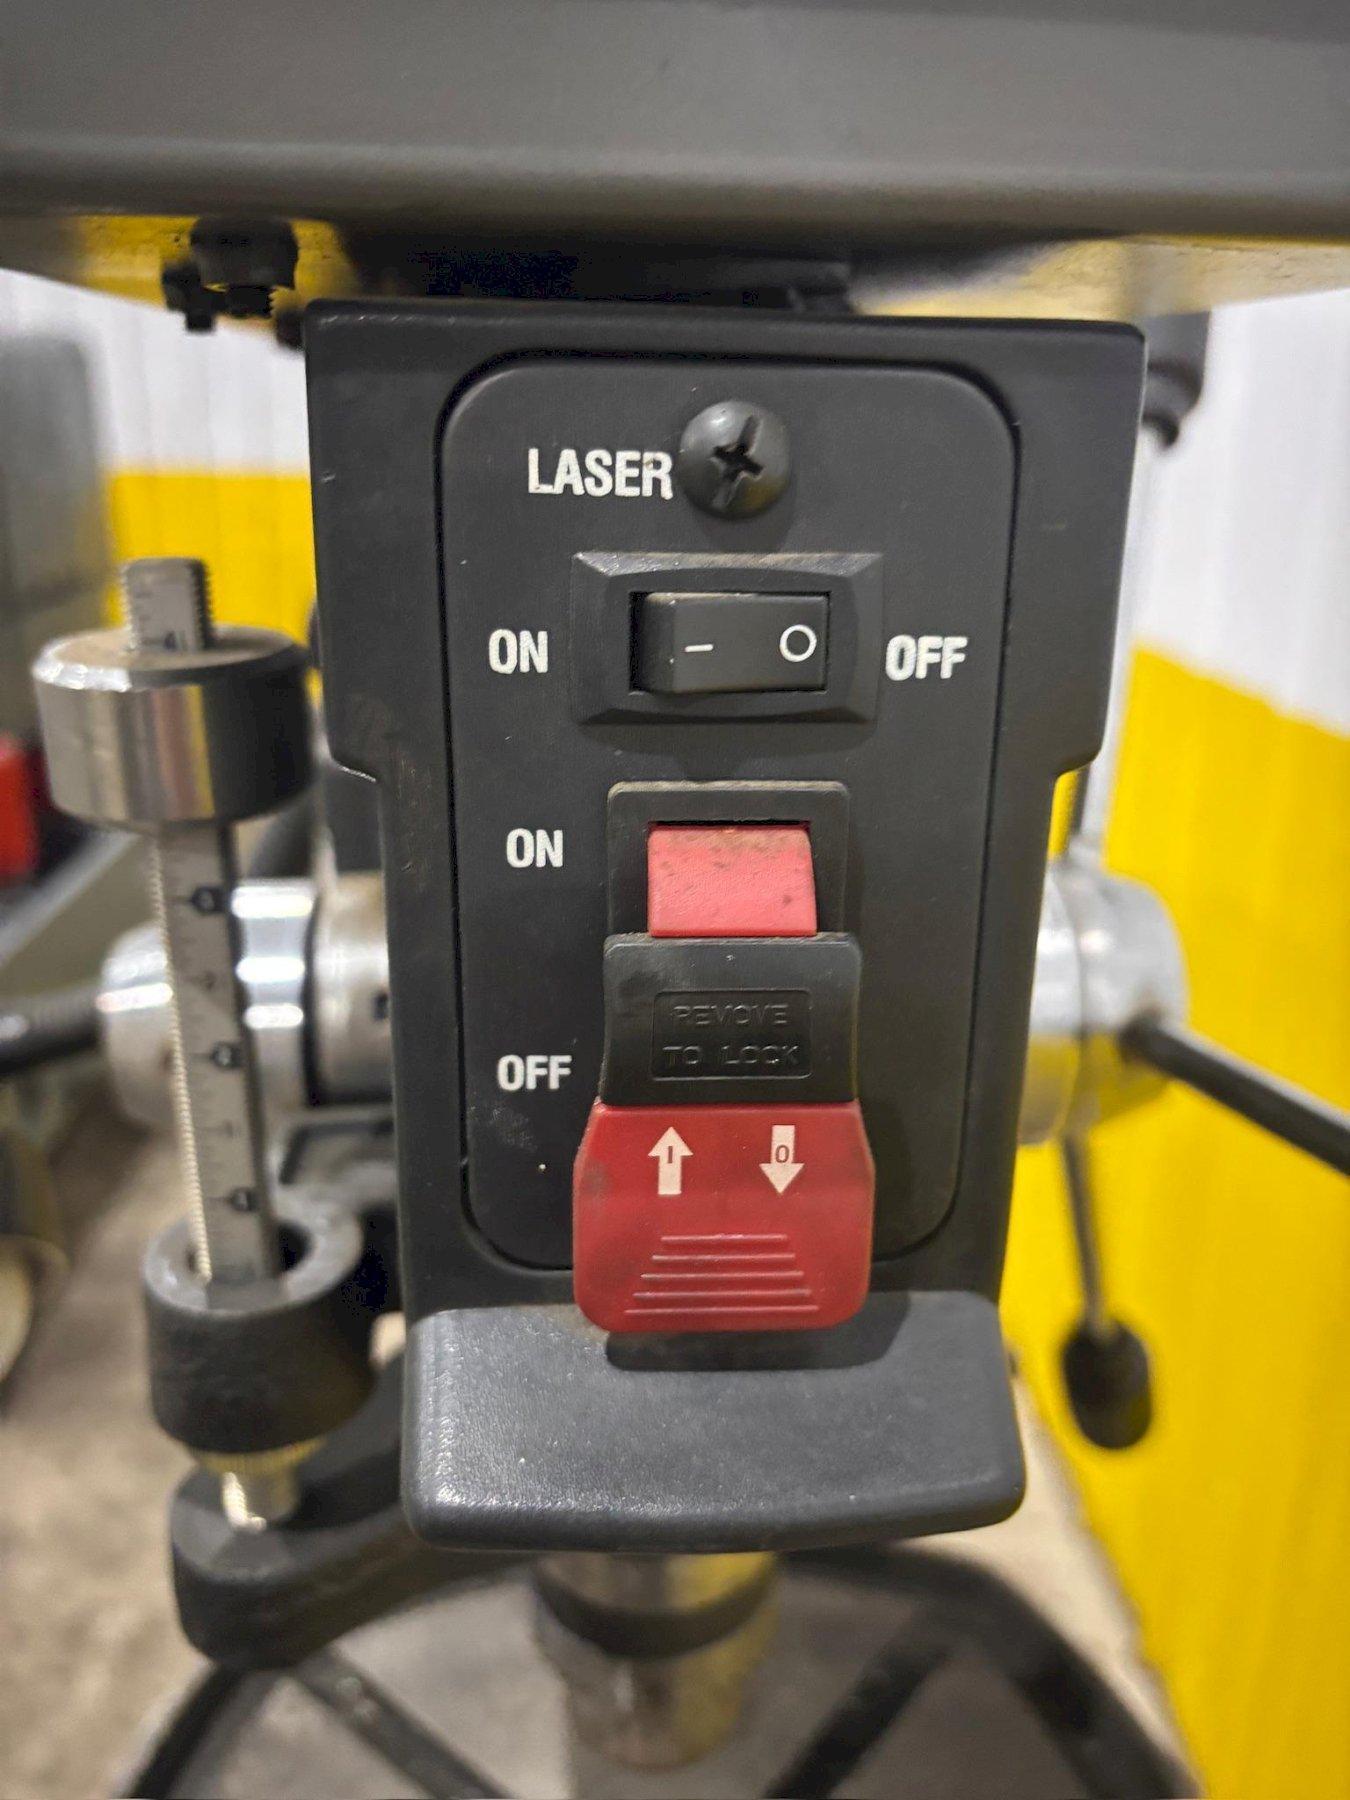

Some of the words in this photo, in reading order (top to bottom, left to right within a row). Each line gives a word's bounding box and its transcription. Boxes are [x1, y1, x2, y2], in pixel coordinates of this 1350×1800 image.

[526, 447, 674, 501] LASER
[488, 628, 550, 675] ON
[885, 634, 969, 682] OFF
[505, 827, 565, 869] ON
[671, 1003, 790, 1026] REMOVE
[496, 1053, 573, 1092] OFF
[661, 1044, 703, 1066] TO
[720, 1043, 801, 1065] LOCK
